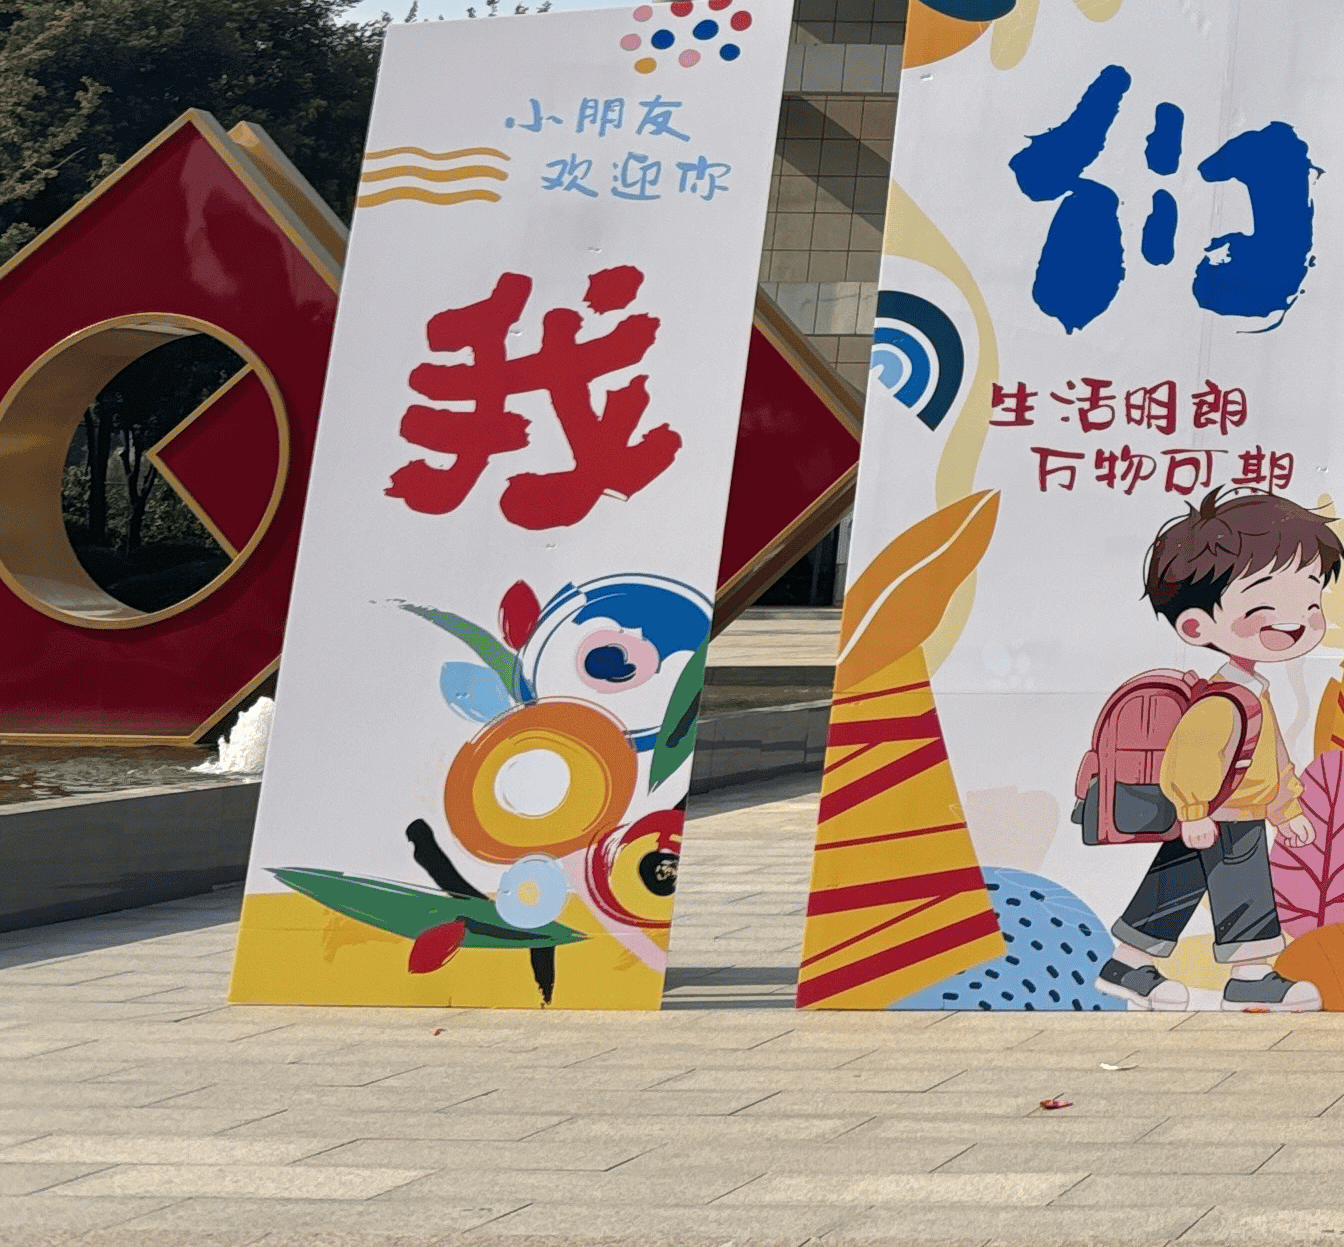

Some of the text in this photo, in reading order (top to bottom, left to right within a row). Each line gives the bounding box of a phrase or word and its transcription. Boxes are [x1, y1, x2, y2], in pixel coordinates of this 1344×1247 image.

[503, 93, 691, 143] 小朋友
[542, 151, 732, 202] 欢迎你
[1008, 63, 1325, 335] 们
[385, 265, 682, 531] 我
[989, 376, 1248, 435] 生活明朗
[1031, 445, 1293, 496] 万物可期
